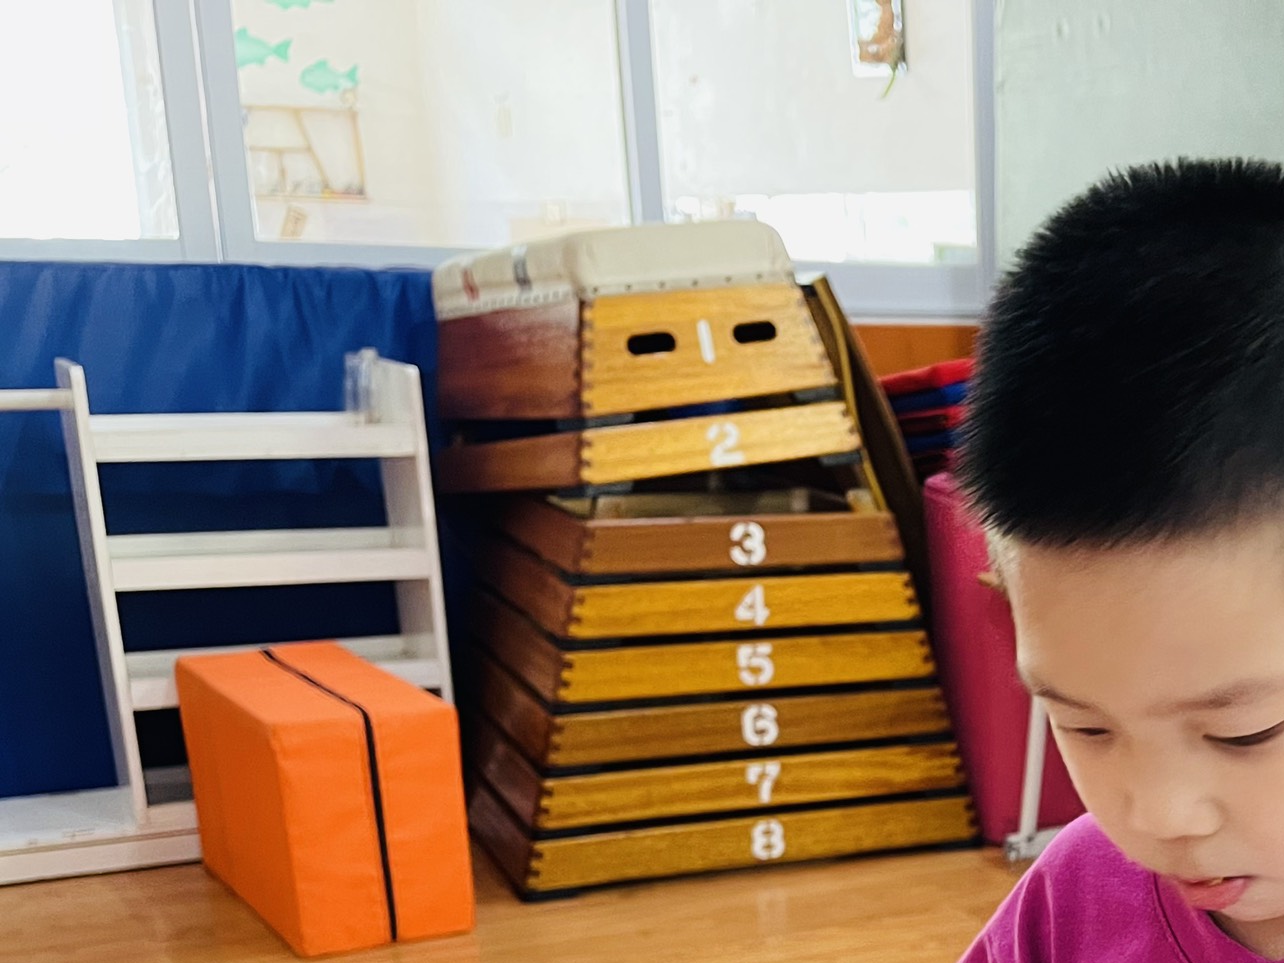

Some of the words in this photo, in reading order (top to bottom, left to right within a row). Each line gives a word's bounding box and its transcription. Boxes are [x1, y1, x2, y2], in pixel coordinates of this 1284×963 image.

[697, 319, 715, 364] 1
[706, 422, 745, 466] 2
[729, 521, 766, 566] 3
[734, 584, 770, 626] 4
[736, 643, 774, 686] 5
[741, 703, 779, 746] 6
[745, 761, 781, 804] 7
[752, 819, 785, 860] 8
